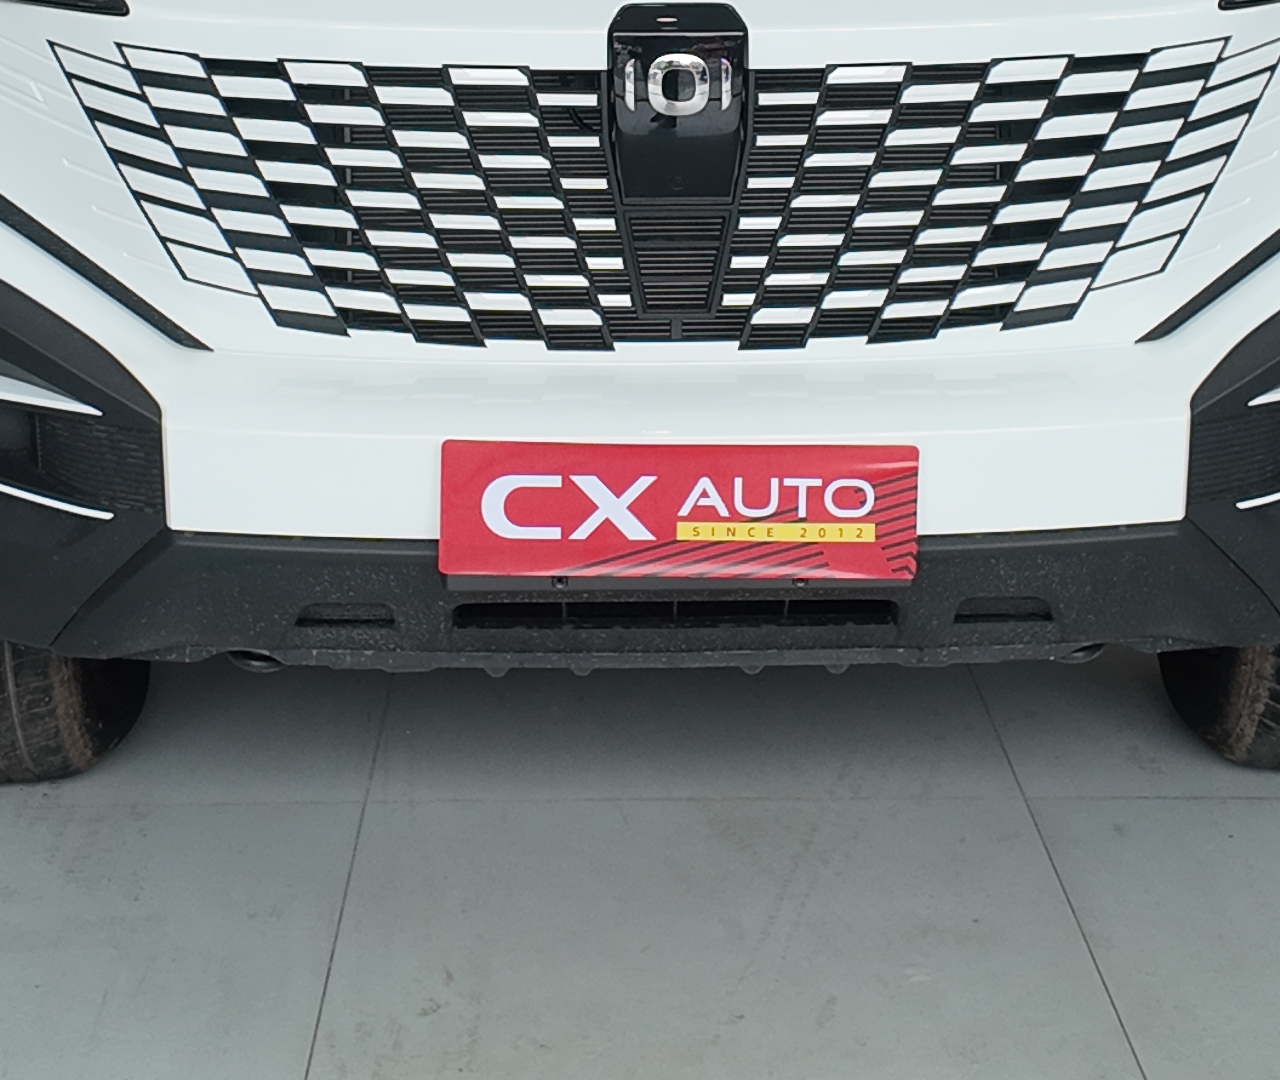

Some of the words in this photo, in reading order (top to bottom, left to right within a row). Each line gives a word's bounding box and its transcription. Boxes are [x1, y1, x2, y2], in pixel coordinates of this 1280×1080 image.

[481, 475, 657, 540] CX
[677, 477, 875, 518] AUTO
[692, 526, 775, 538] SINCE
[800, 526, 865, 538] 2012
